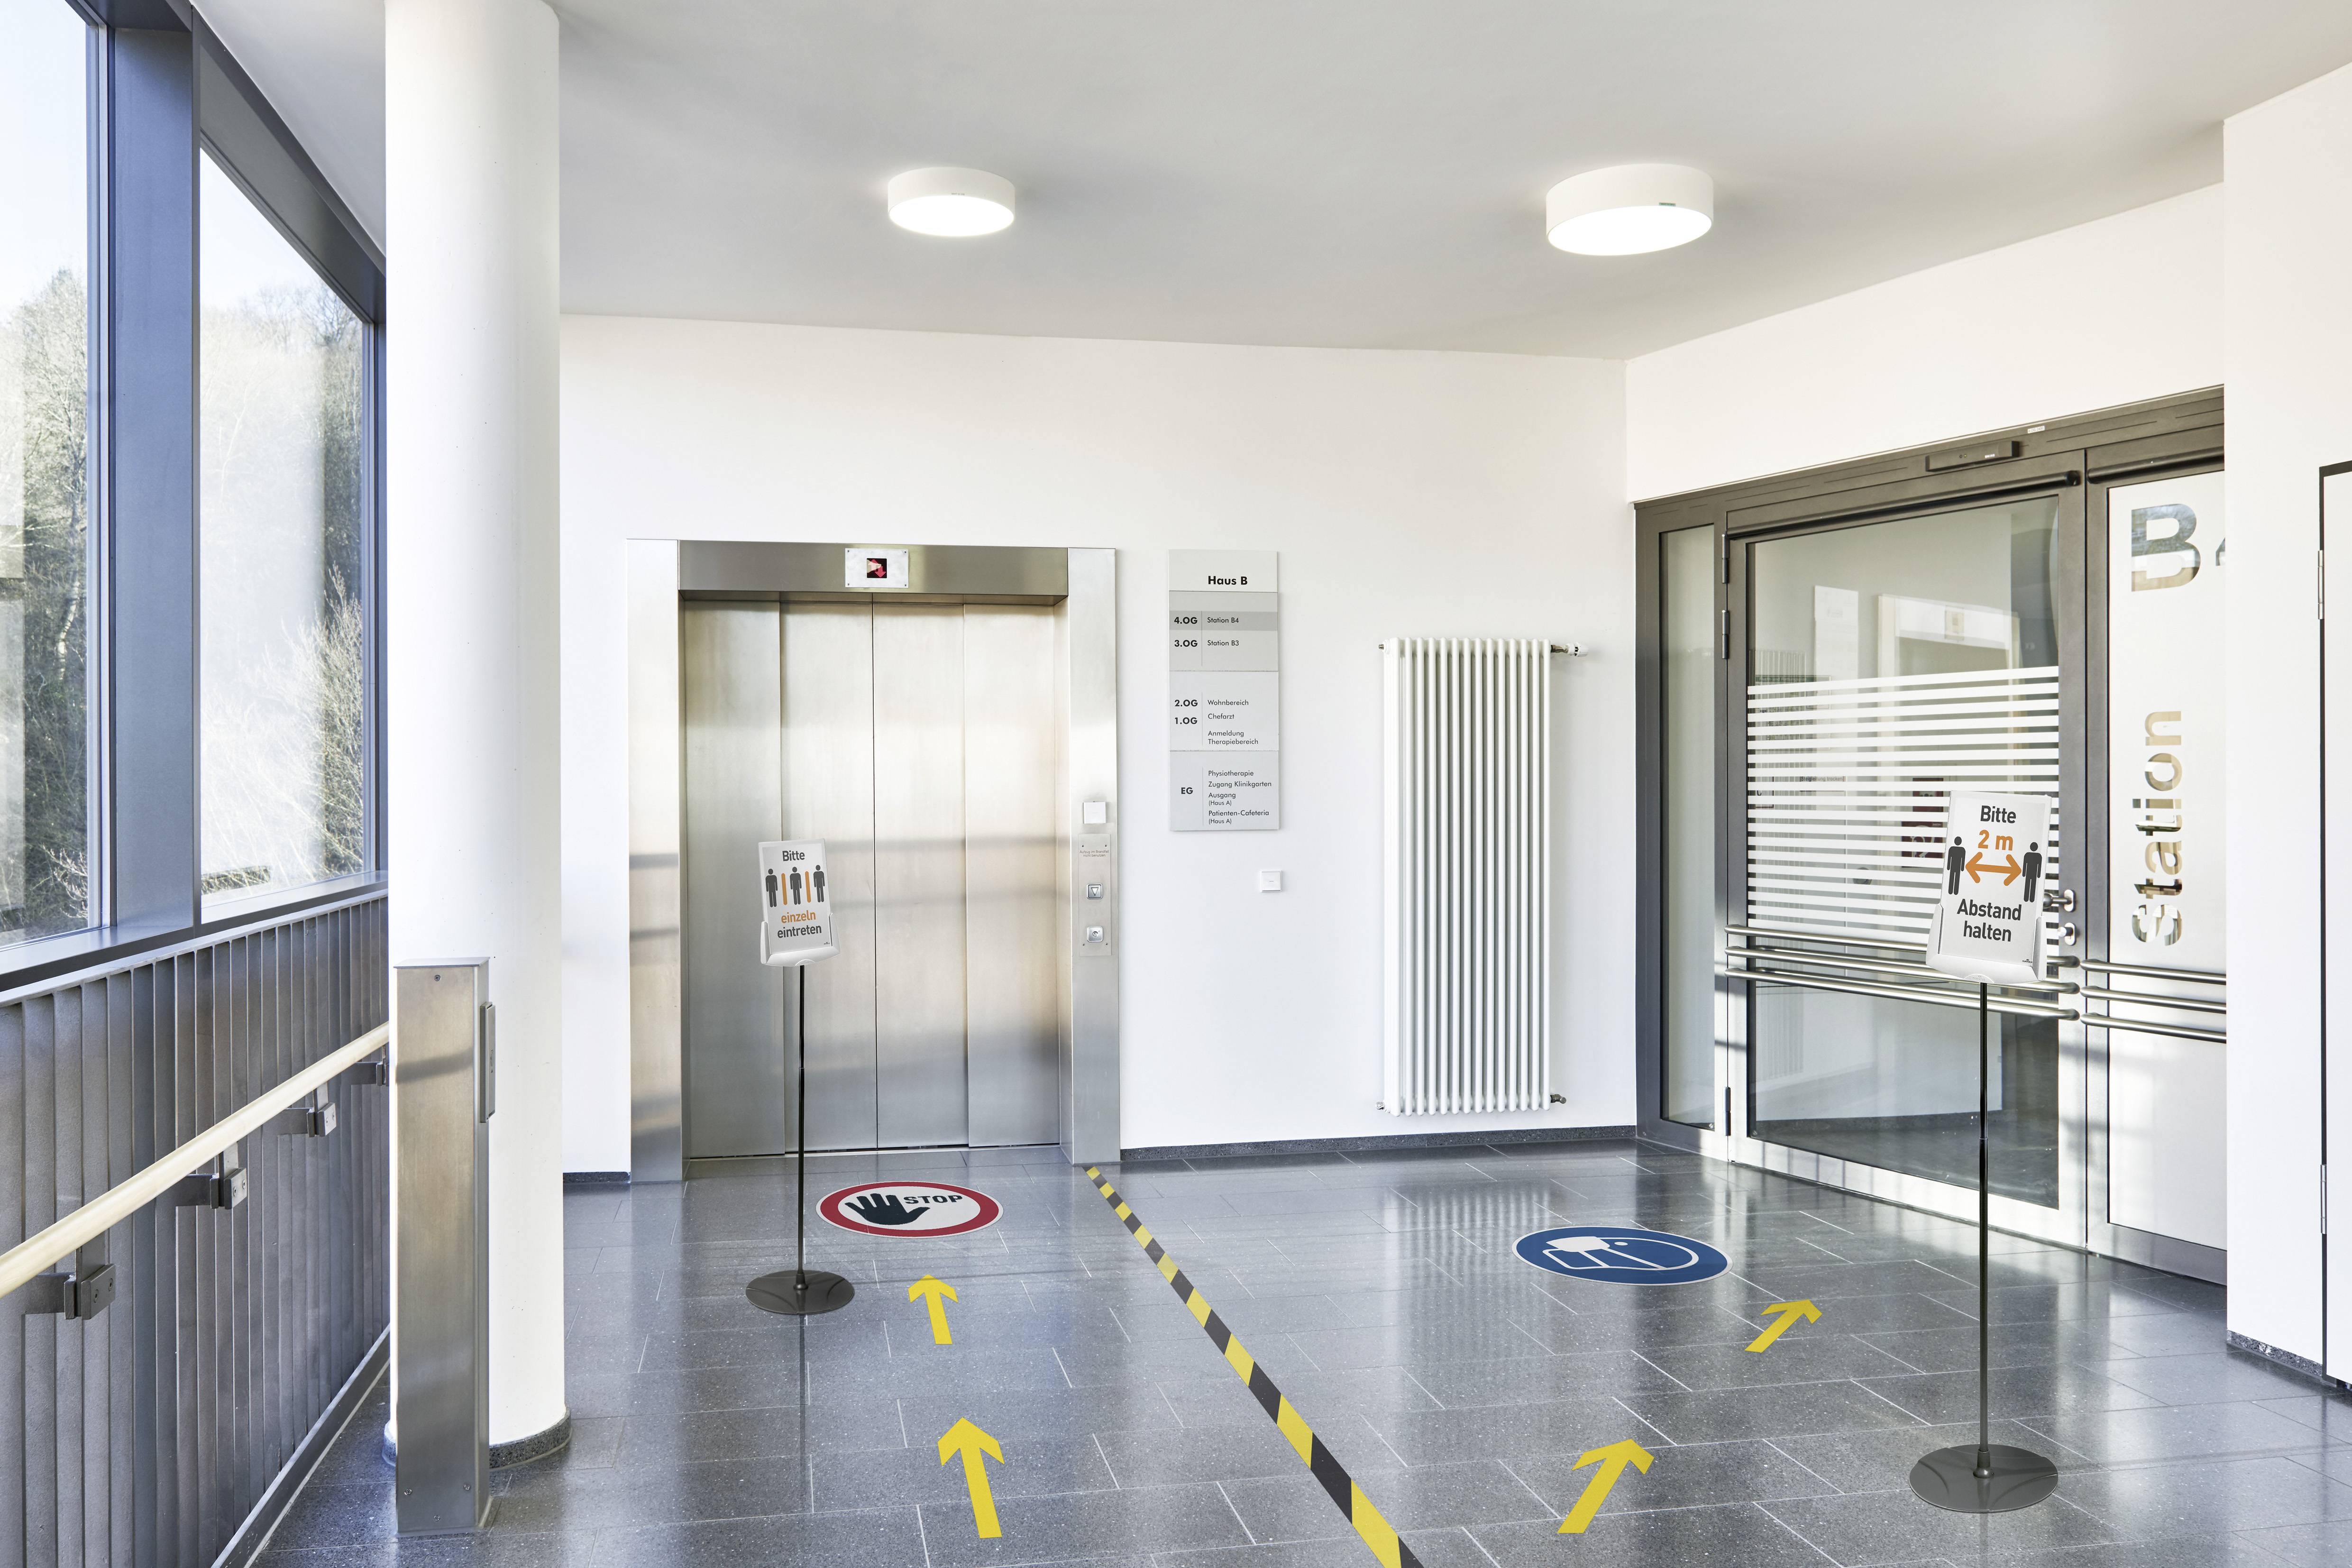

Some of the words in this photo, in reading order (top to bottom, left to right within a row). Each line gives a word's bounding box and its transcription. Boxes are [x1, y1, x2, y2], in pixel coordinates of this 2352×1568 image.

[1208, 575, 1237, 585] Haus
[1241, 576, 1248, 585] B
[1174, 616, 1198, 624] 4.OG
[1181, 787, 1193, 795] EG
[1980, 805, 2016, 824] Bitte
[2132, 711, 2183, 946] Station
[1977, 829, 1990, 849] 2
[1995, 835, 2013, 851] m
[782, 850, 805, 862] Bitte
[1957, 898, 2022, 921] Abstand
[781, 910, 816, 924] einzeln
[777, 925, 822, 938] eintreten
[1963, 920, 2012, 942] halten
[903, 1194, 963, 1204] STOP
